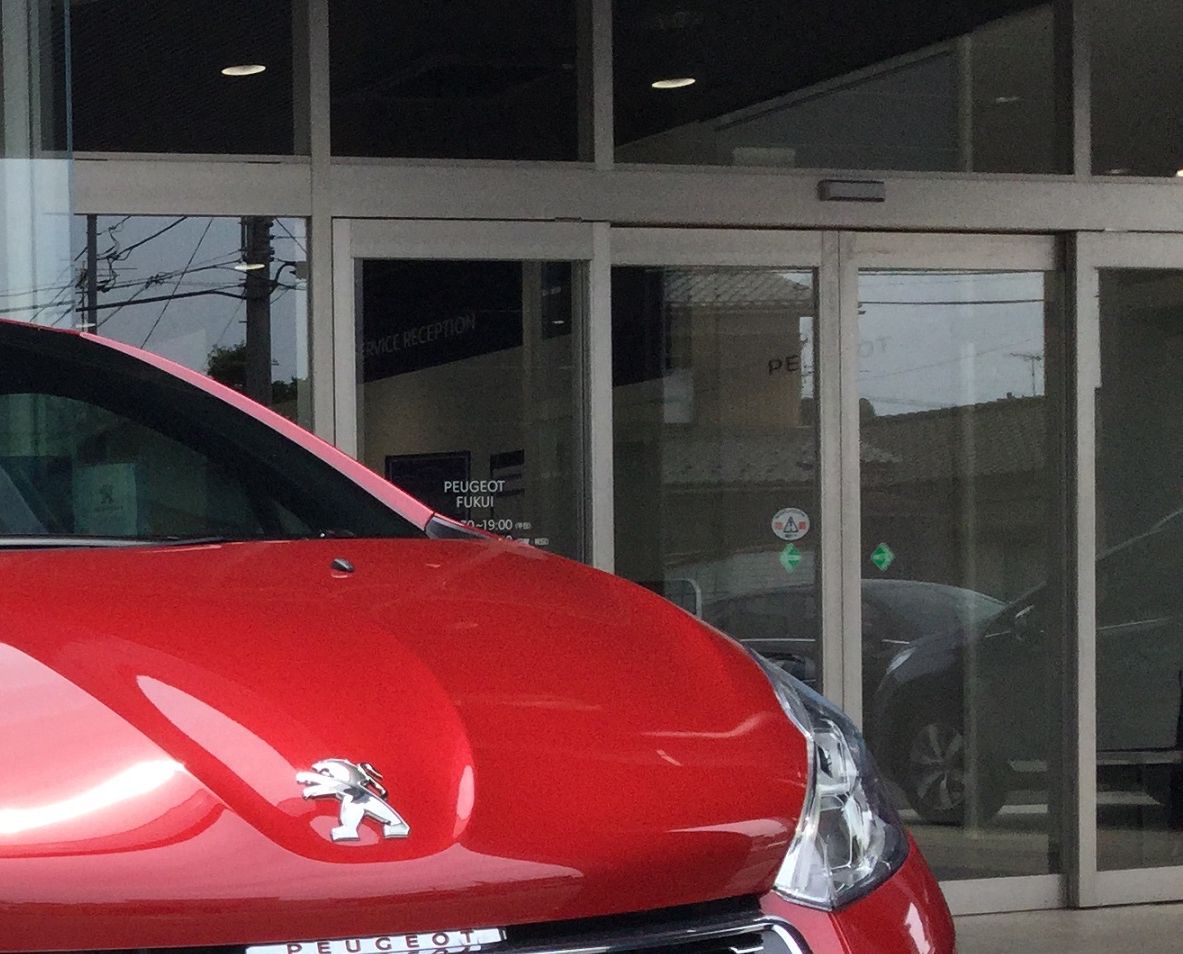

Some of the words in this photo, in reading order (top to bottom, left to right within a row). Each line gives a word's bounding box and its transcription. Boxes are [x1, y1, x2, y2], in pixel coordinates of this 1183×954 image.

[403, 312, 476, 348] RECEPTION
[443, 480, 506, 494] PEUGEOT
[456, 496, 494, 508] FUKUI
